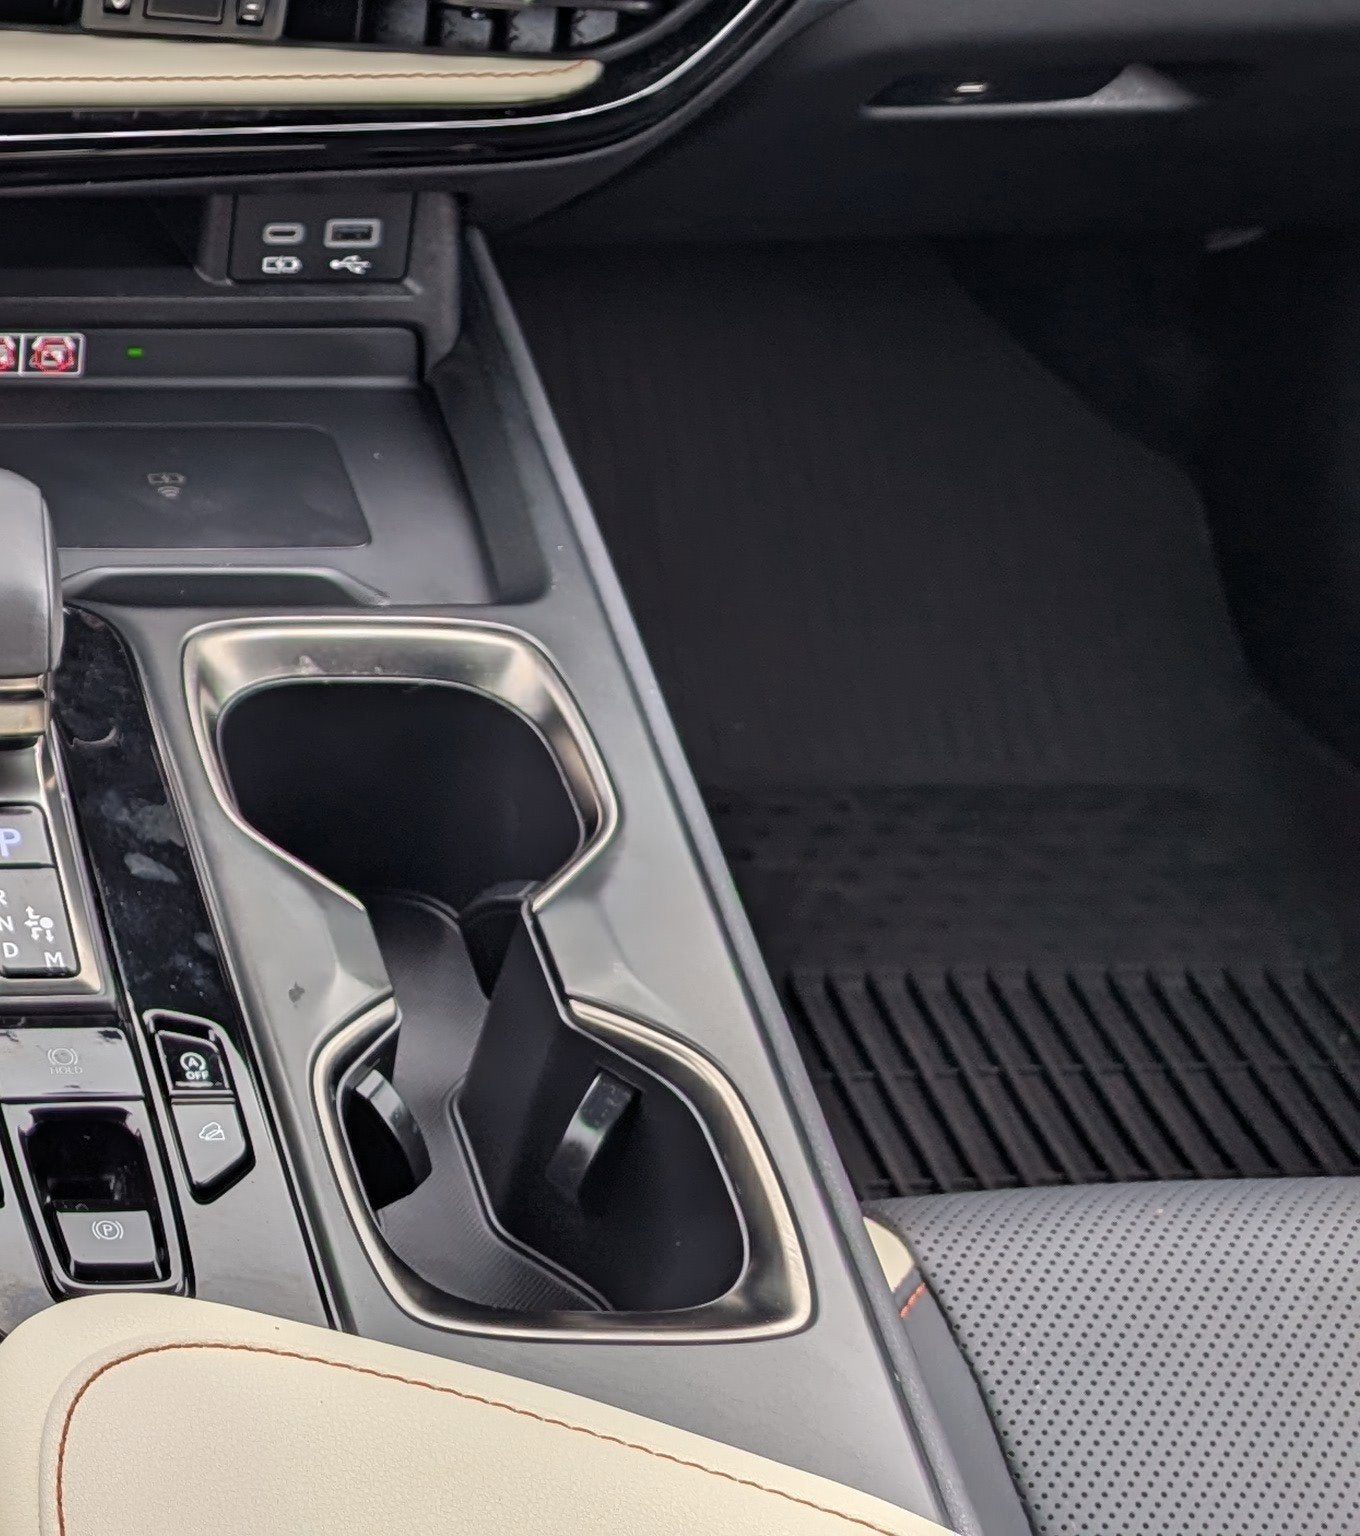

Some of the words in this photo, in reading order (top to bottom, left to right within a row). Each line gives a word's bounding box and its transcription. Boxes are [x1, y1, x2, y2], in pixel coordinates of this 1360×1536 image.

[2, 942, 19, 959] D
[44, 951, 65, 969] M
[49, 1065, 83, 1076] HOLD
[185, 1070, 209, 1080] OFF
